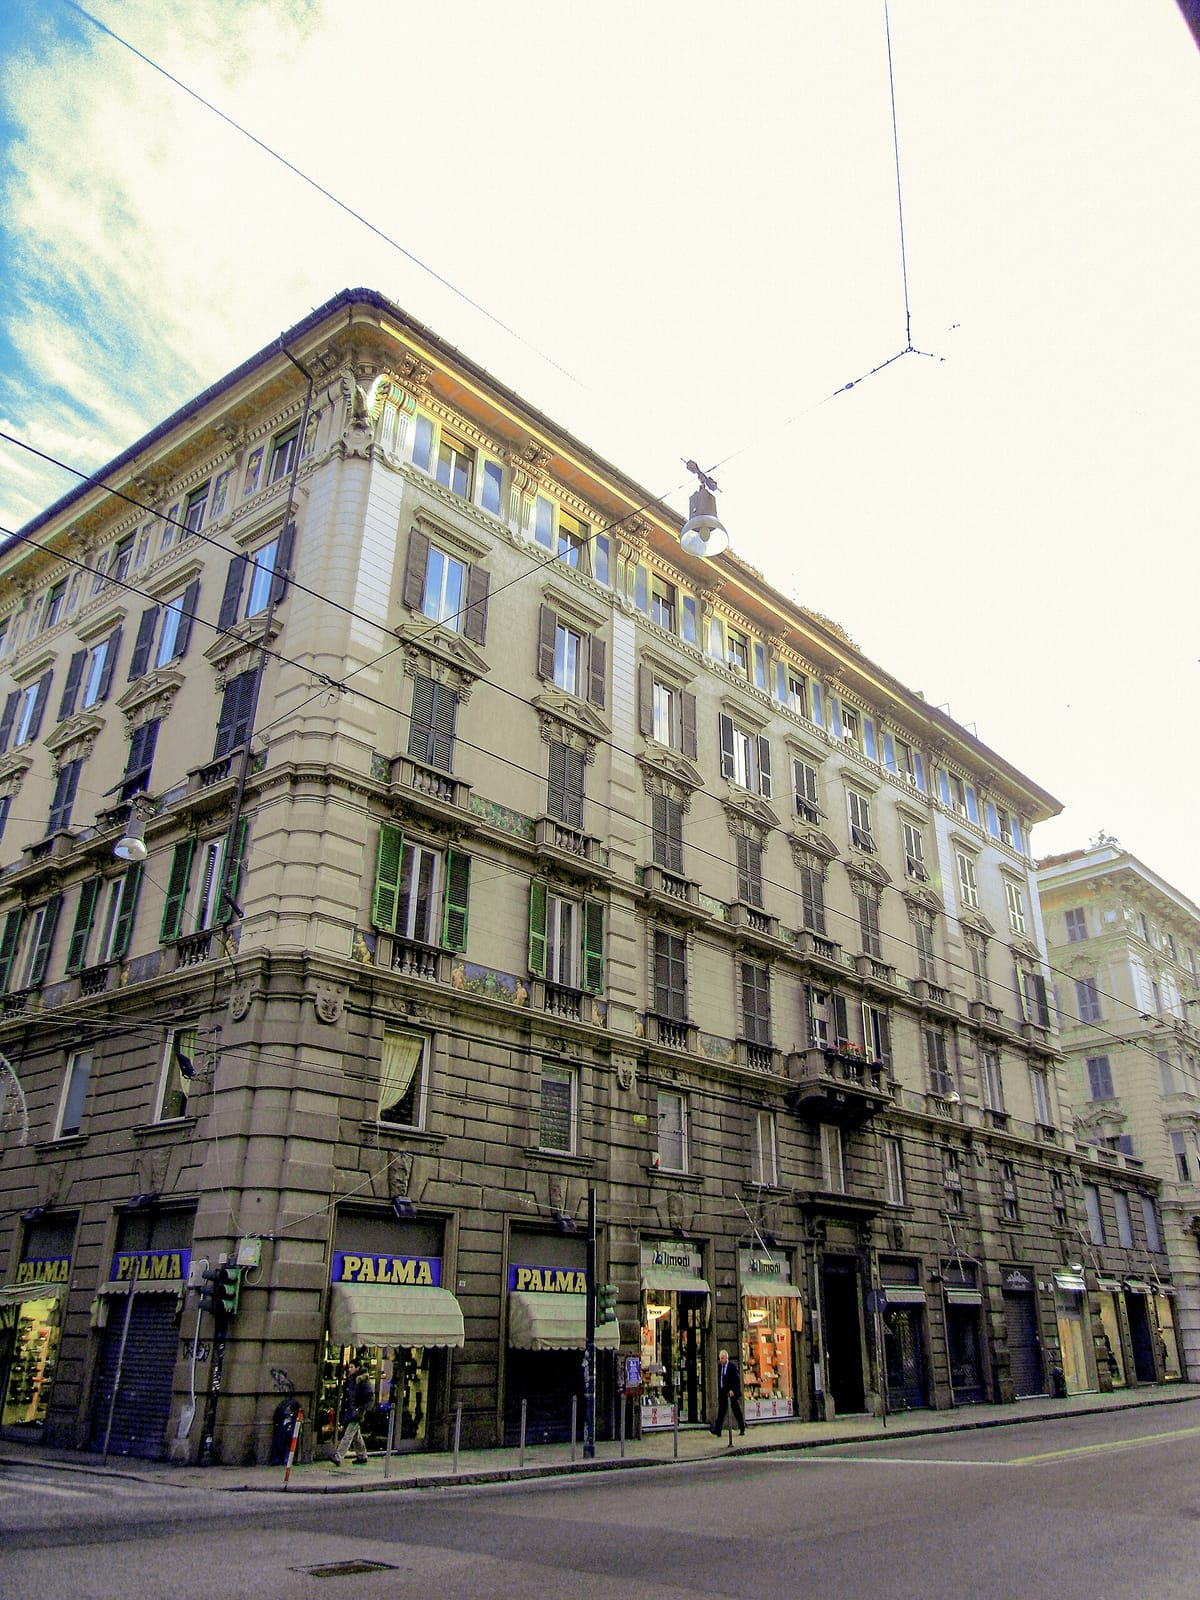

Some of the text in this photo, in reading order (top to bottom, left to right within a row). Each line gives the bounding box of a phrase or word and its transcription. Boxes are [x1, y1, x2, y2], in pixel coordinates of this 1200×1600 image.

[16, 1260, 69, 1283] PALMA
[342, 1256, 432, 1284] PALMA
[516, 1268, 587, 1293] PALMA
